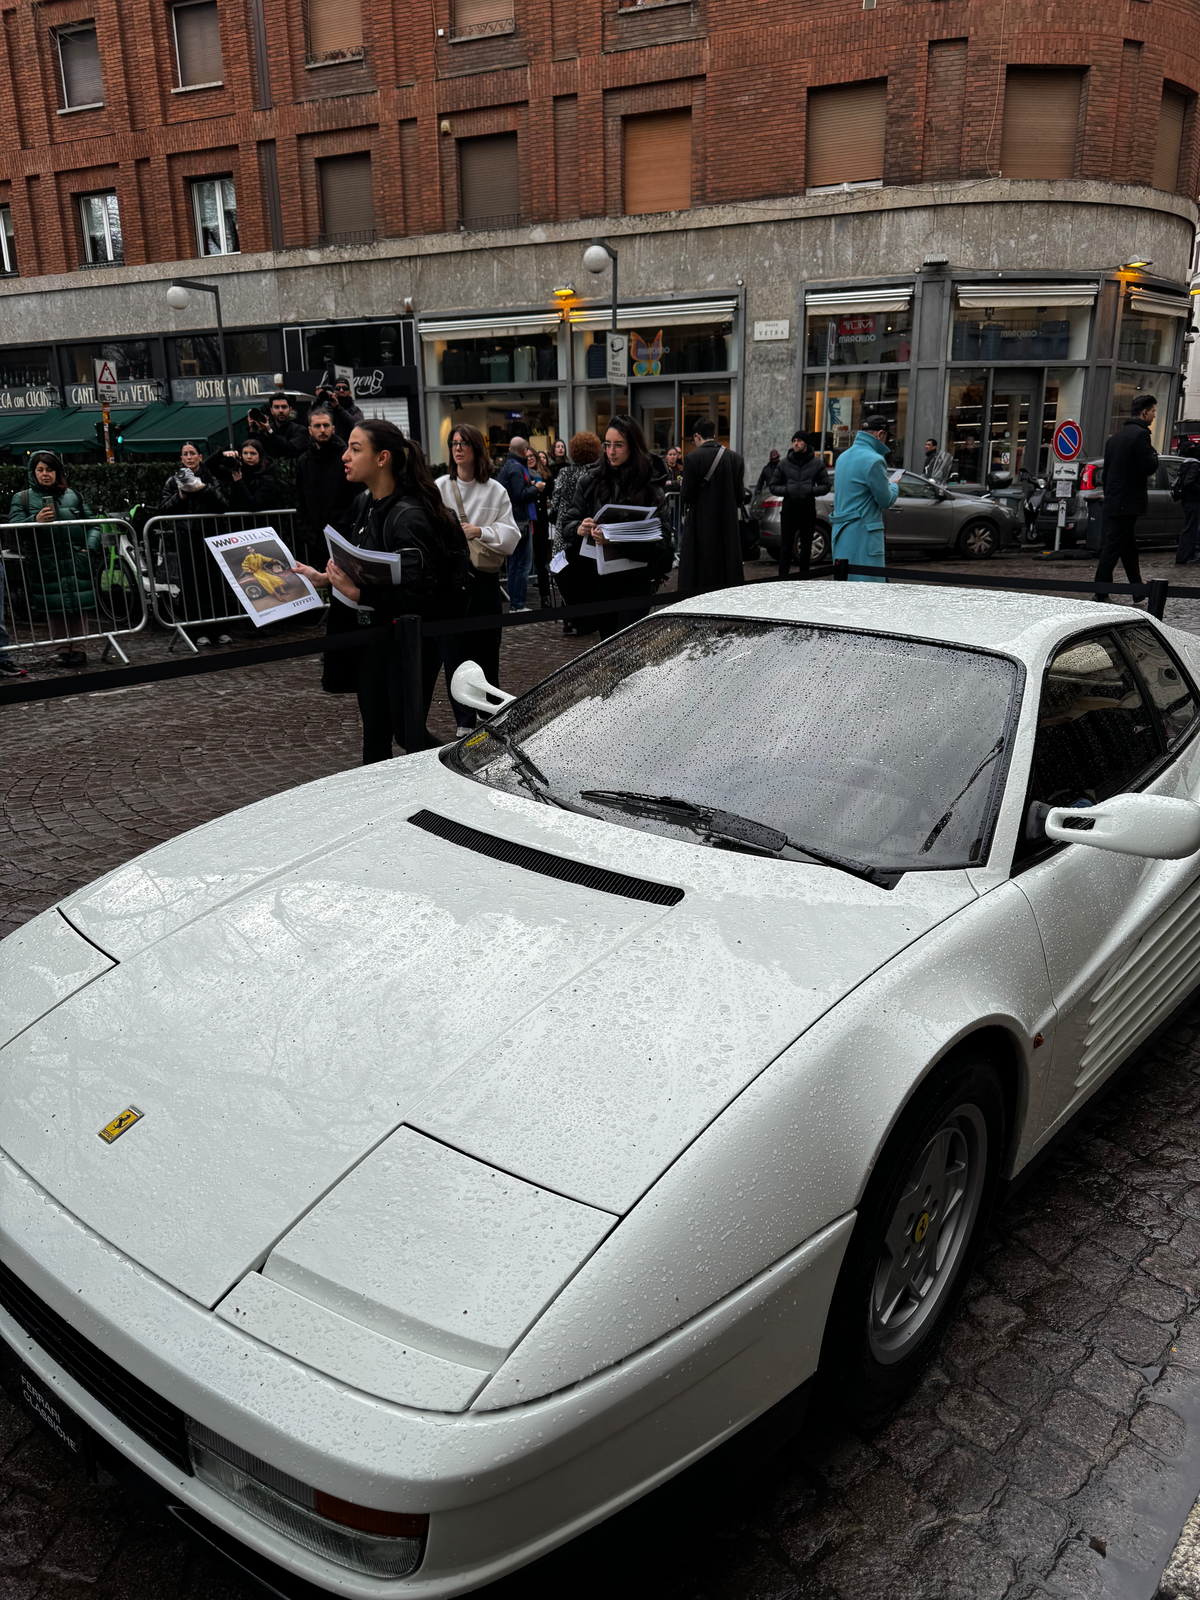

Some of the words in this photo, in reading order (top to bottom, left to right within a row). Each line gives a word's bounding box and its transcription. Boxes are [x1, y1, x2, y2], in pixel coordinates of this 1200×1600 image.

[130, 385, 158, 402] VETR
[242, 378, 259, 396] VIN
[26, 390, 52, 407] CUCIN
[211, 537, 239, 548] WWD
[20, 1374, 61, 1424] FERRARI
[23, 1389, 77, 1453] CLASSICHE
